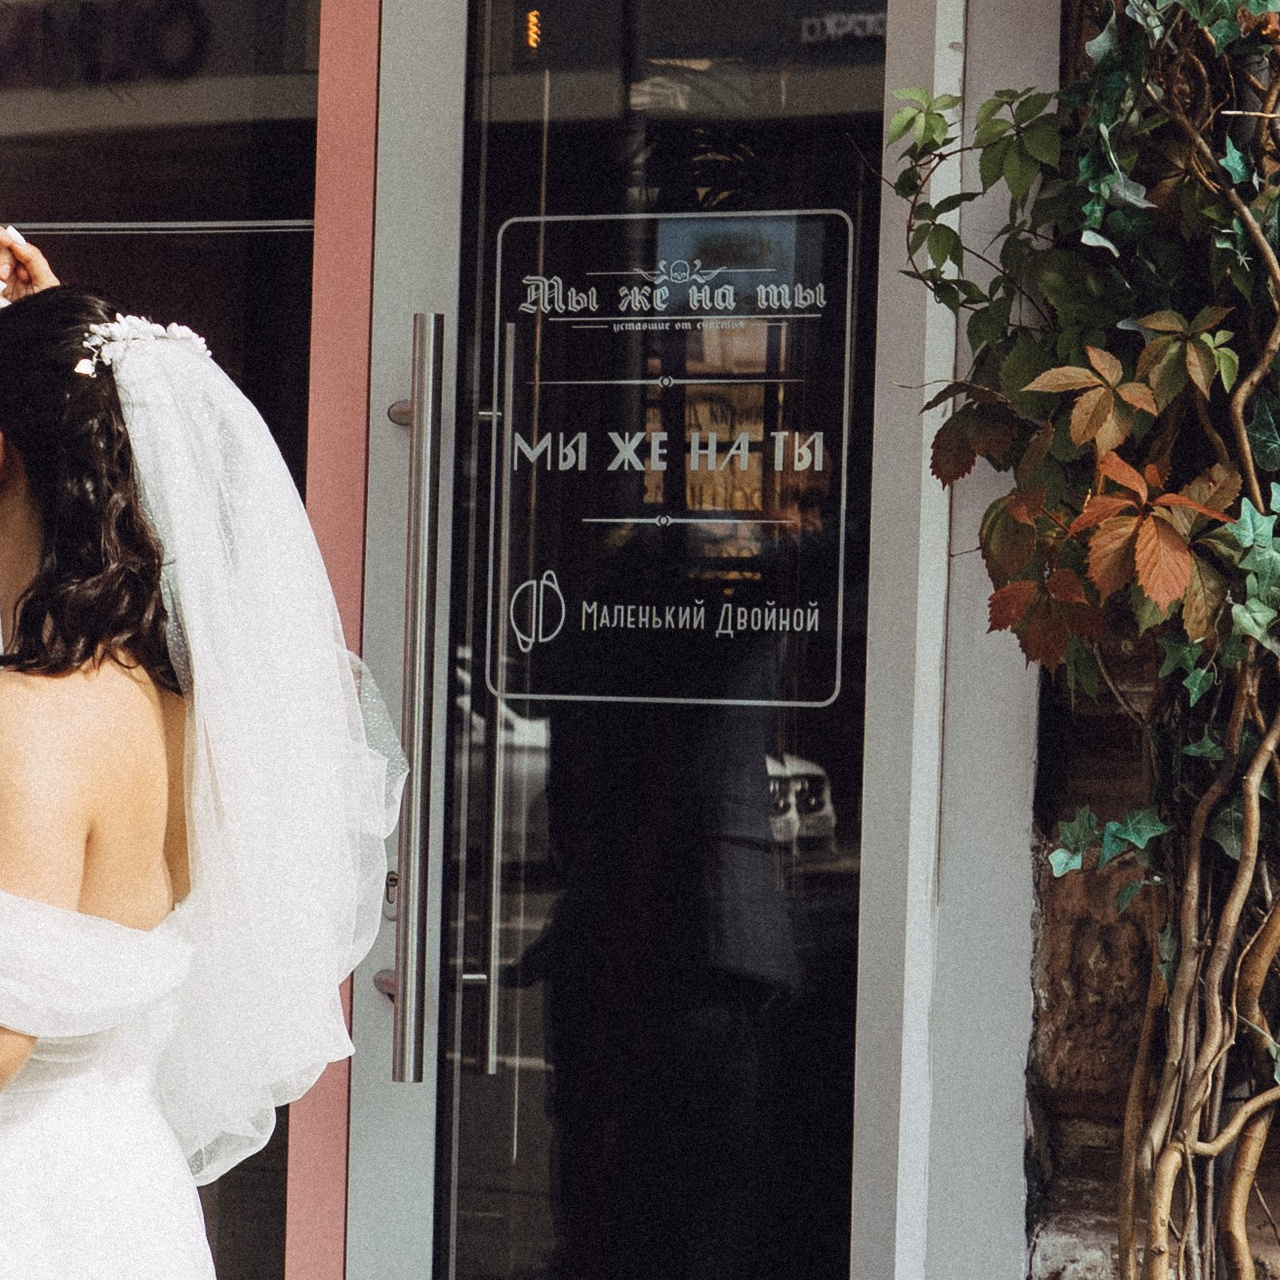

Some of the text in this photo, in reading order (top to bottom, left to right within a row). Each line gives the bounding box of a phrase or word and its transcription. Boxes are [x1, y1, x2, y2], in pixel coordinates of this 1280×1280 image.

[618, 281, 670, 312] же
[688, 281, 736, 310] на
[757, 281, 827, 308] ты
[513, 432, 824, 471] МЫ ЖЕ НА ТЫ
